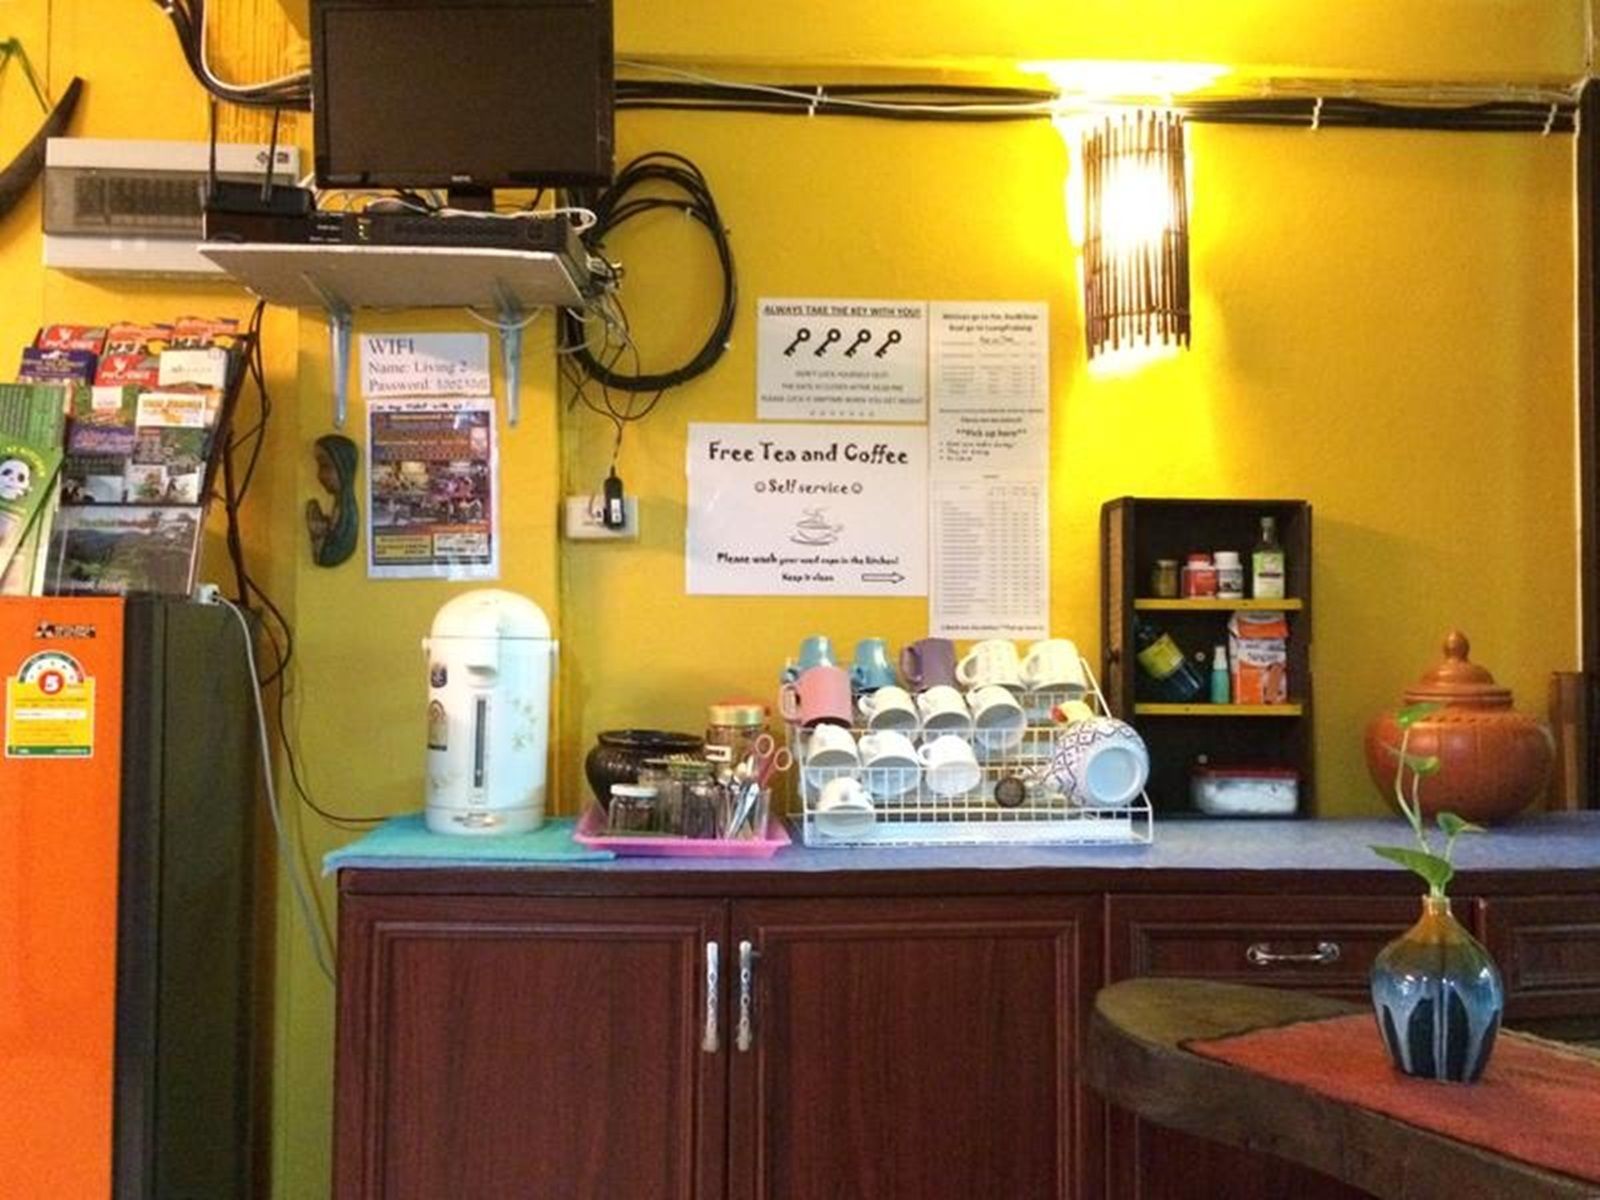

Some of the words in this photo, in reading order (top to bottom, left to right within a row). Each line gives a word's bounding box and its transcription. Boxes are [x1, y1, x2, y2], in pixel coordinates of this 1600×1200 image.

[765, 305, 802, 316] ALWAYS
[806, 305, 828, 316] TAKE
[831, 306, 848, 316] THE
[850, 307, 868, 317] KEY
[870, 307, 894, 317] WITH
[368, 338, 414, 354] WIFI
[368, 361, 409, 374] Name:
[414, 361, 455, 375] Living
[368, 379, 431, 393] Password:
[708, 441, 754, 462] Free
[758, 441, 797, 462] Tea
[801, 444, 837, 462] and
[844, 443, 909, 464] Coffee
[768, 479, 797, 494] Self
[799, 480, 849, 494] service
[716, 553, 749, 565] Please
[752, 553, 777, 564] wash
[851, 556, 864, 565] the
[782, 573, 802, 582] Keep
